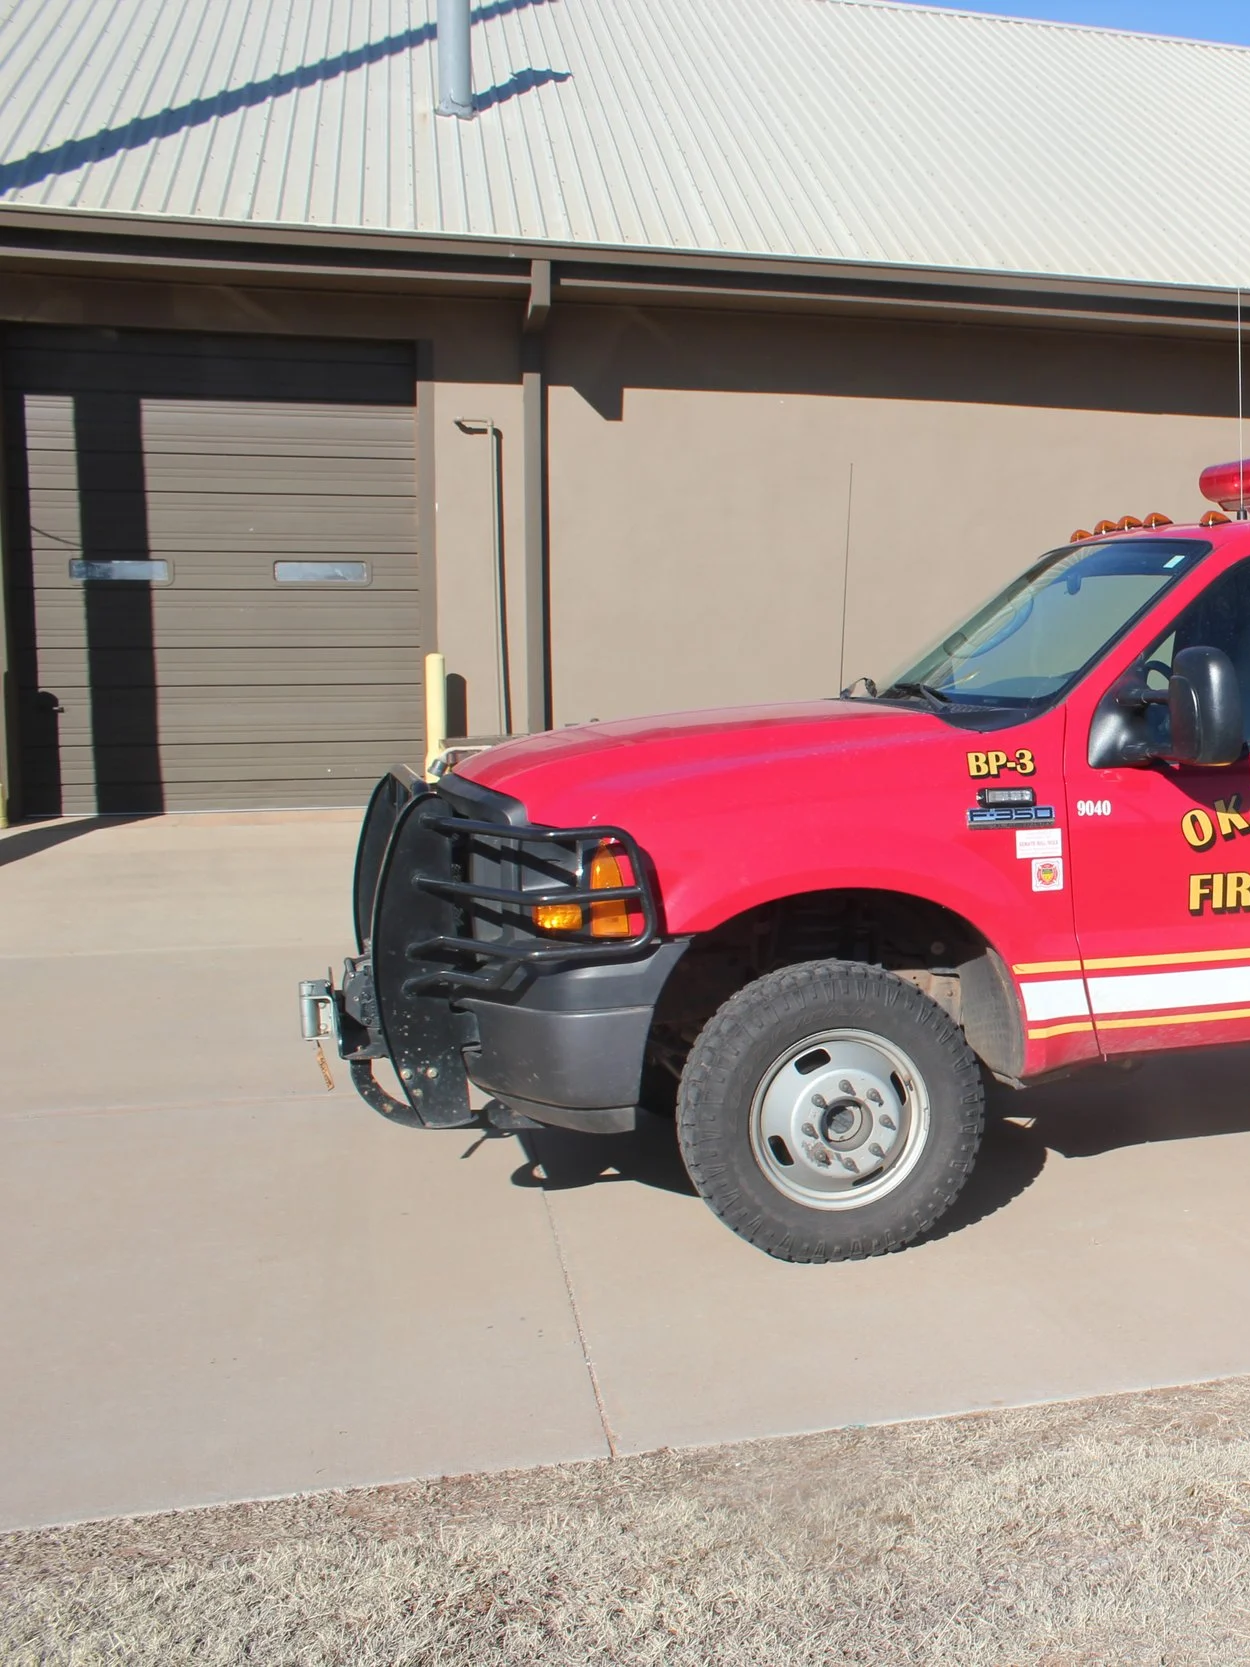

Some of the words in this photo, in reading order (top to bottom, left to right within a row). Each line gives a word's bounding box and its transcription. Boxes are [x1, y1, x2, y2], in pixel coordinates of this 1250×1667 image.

[967, 749, 1035, 777] BP-3
[969, 806, 1054, 822] F-350
[1077, 800, 1112, 816] 9040
